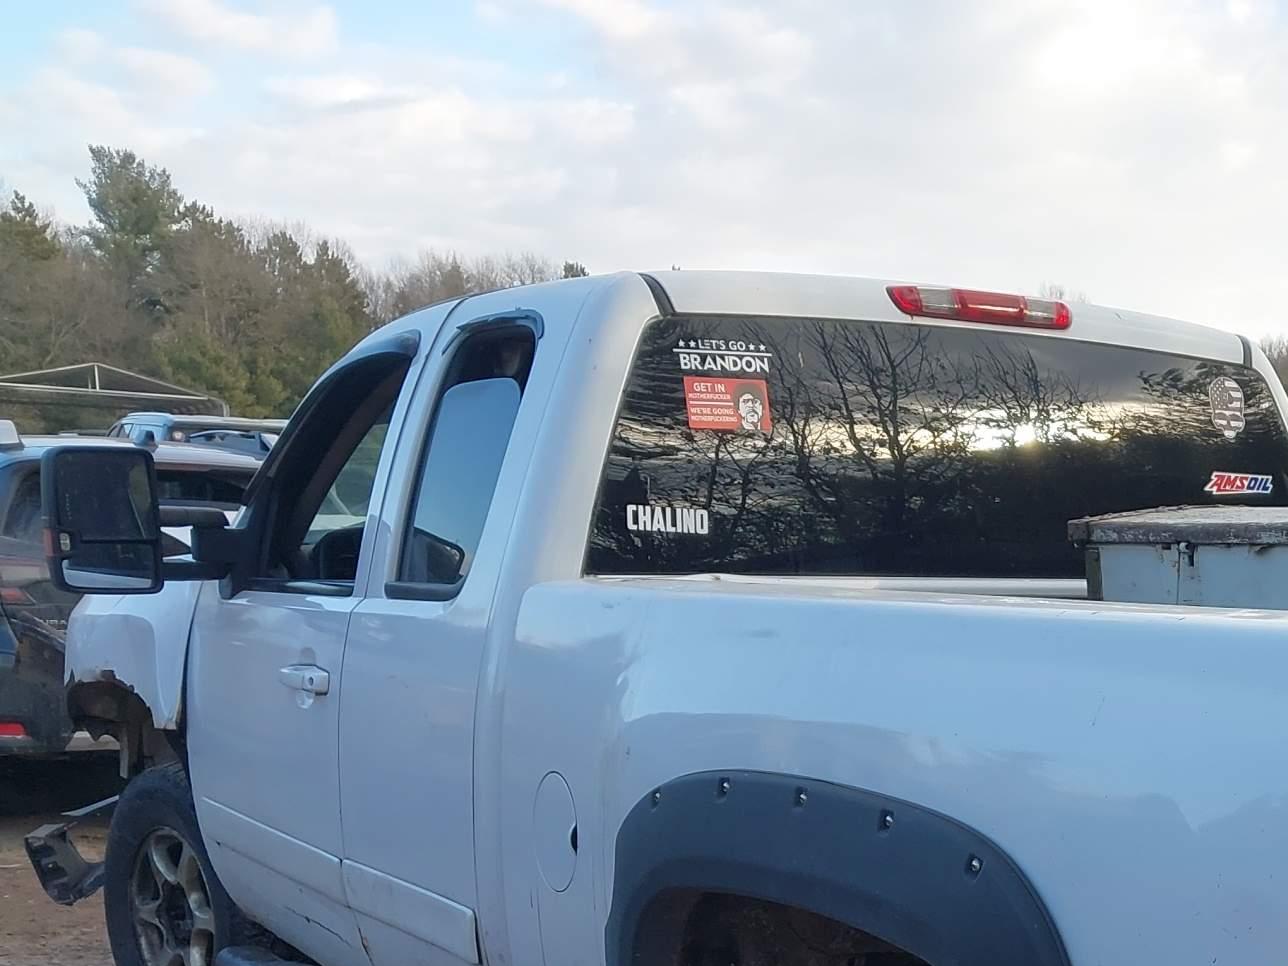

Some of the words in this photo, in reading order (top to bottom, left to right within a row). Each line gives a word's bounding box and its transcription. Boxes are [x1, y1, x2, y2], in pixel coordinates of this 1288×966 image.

[698, 339, 726, 350] LET'S
[728, 340, 746, 351] GO
[679, 353, 770, 373] BRANDON
[693, 382, 713, 392] GET
[714, 383, 726, 393] IN
[712, 407, 734, 415] GOING
[1207, 473, 1273, 493] AMSOIL
[626, 504, 709, 535] CHALINO
